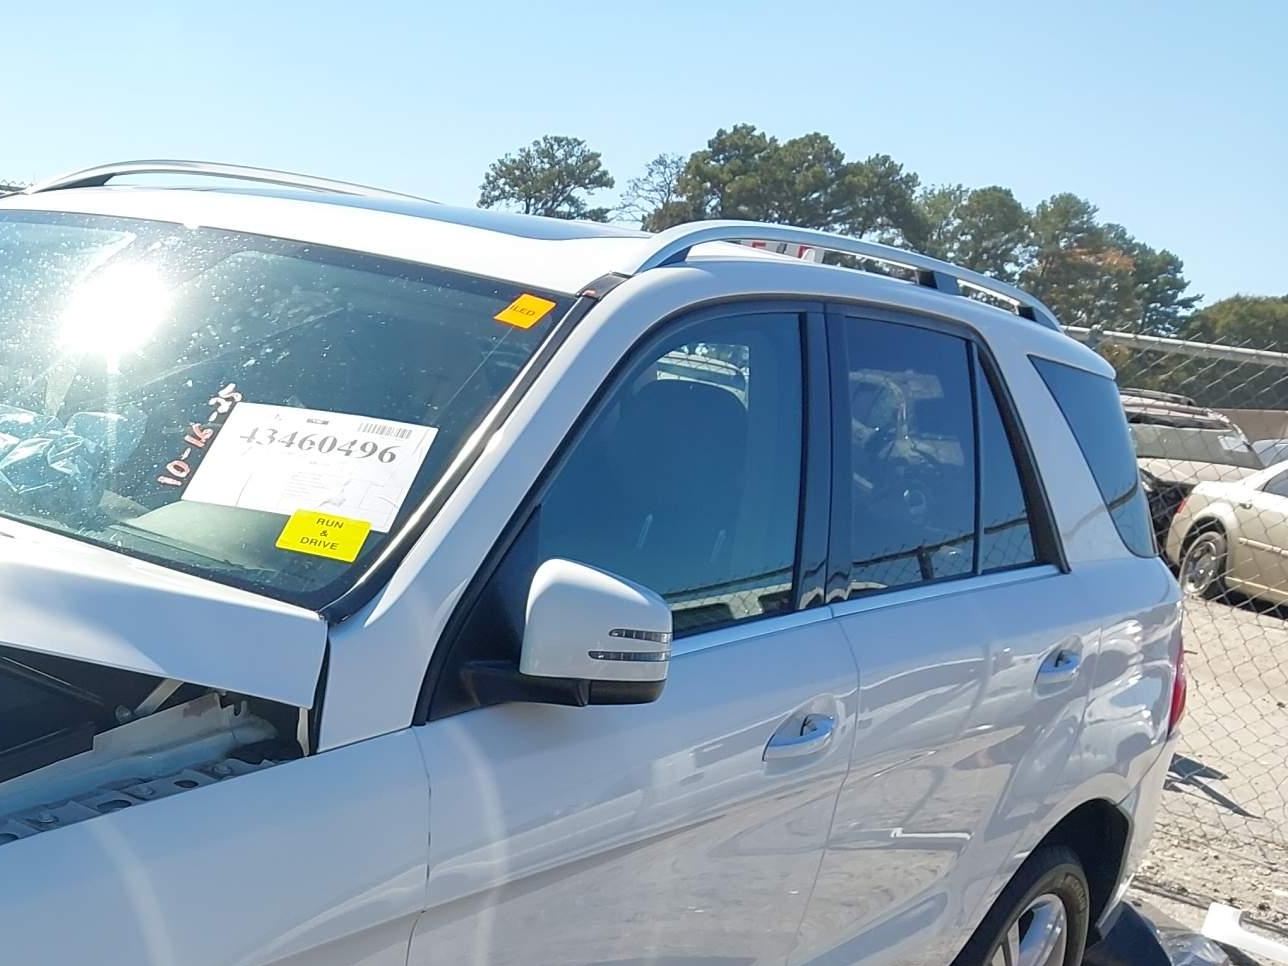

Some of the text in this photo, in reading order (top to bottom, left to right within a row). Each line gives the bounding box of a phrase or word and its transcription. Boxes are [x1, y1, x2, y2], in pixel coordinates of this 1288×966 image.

[240, 427, 401, 464] 43460496
[315, 517, 345, 530] RUN
[319, 529, 329, 538] &
[299, 536, 340, 551] DRIVE
